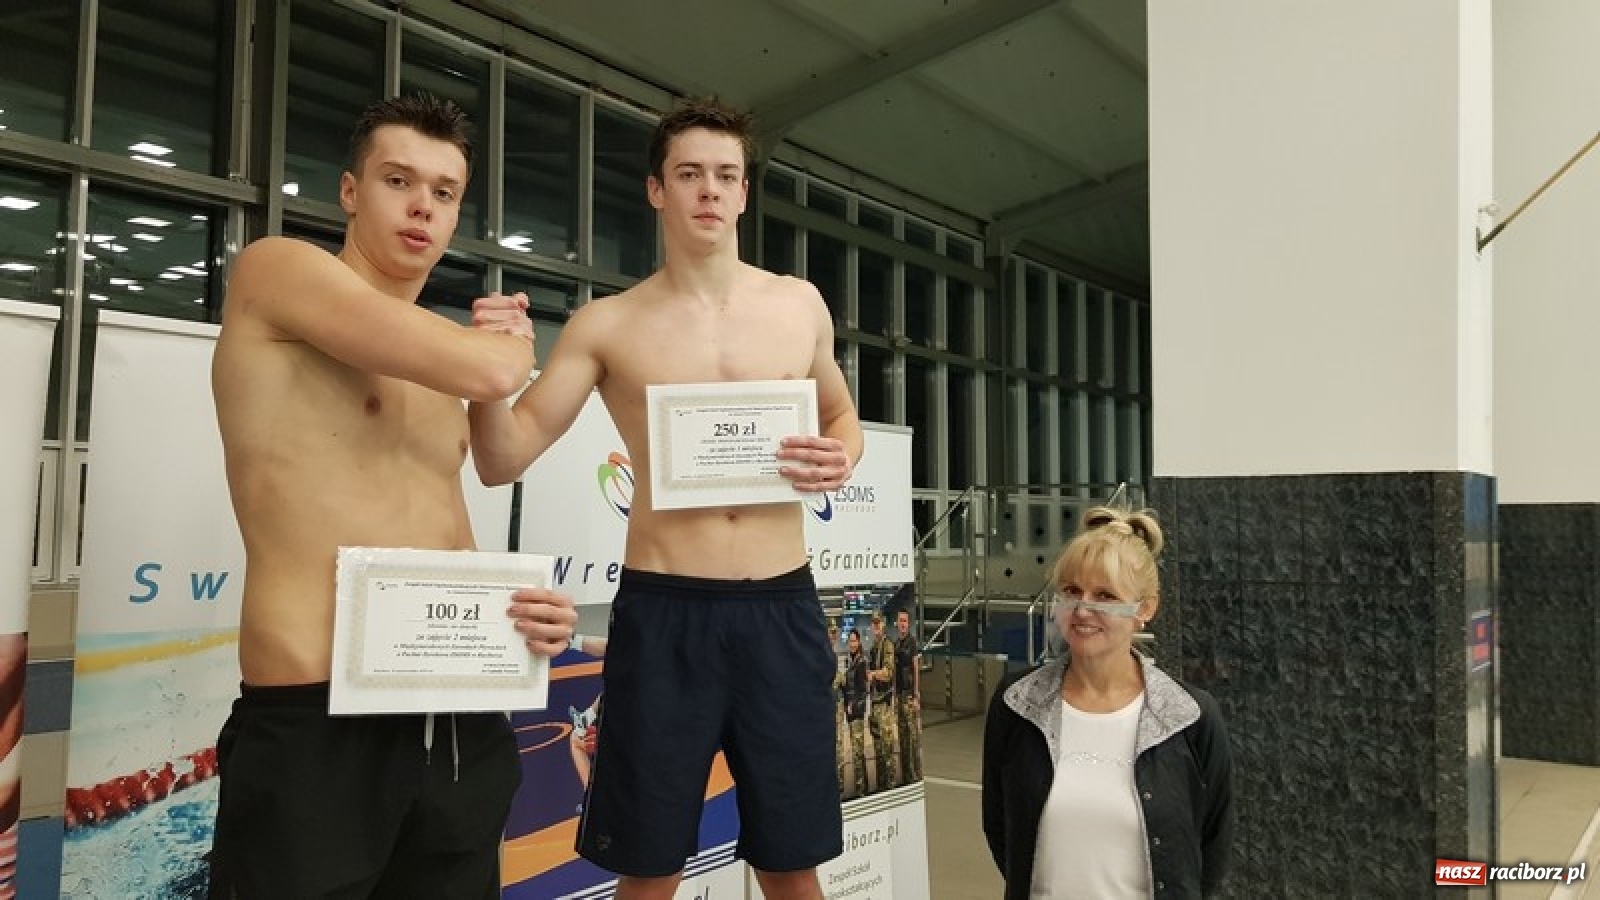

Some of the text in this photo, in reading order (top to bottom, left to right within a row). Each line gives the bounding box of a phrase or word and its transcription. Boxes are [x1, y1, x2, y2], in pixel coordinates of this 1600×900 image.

[714, 422, 756, 436] 250 zł
[820, 548, 908, 570] Graniczna
[426, 603, 480, 620] 100 zł
